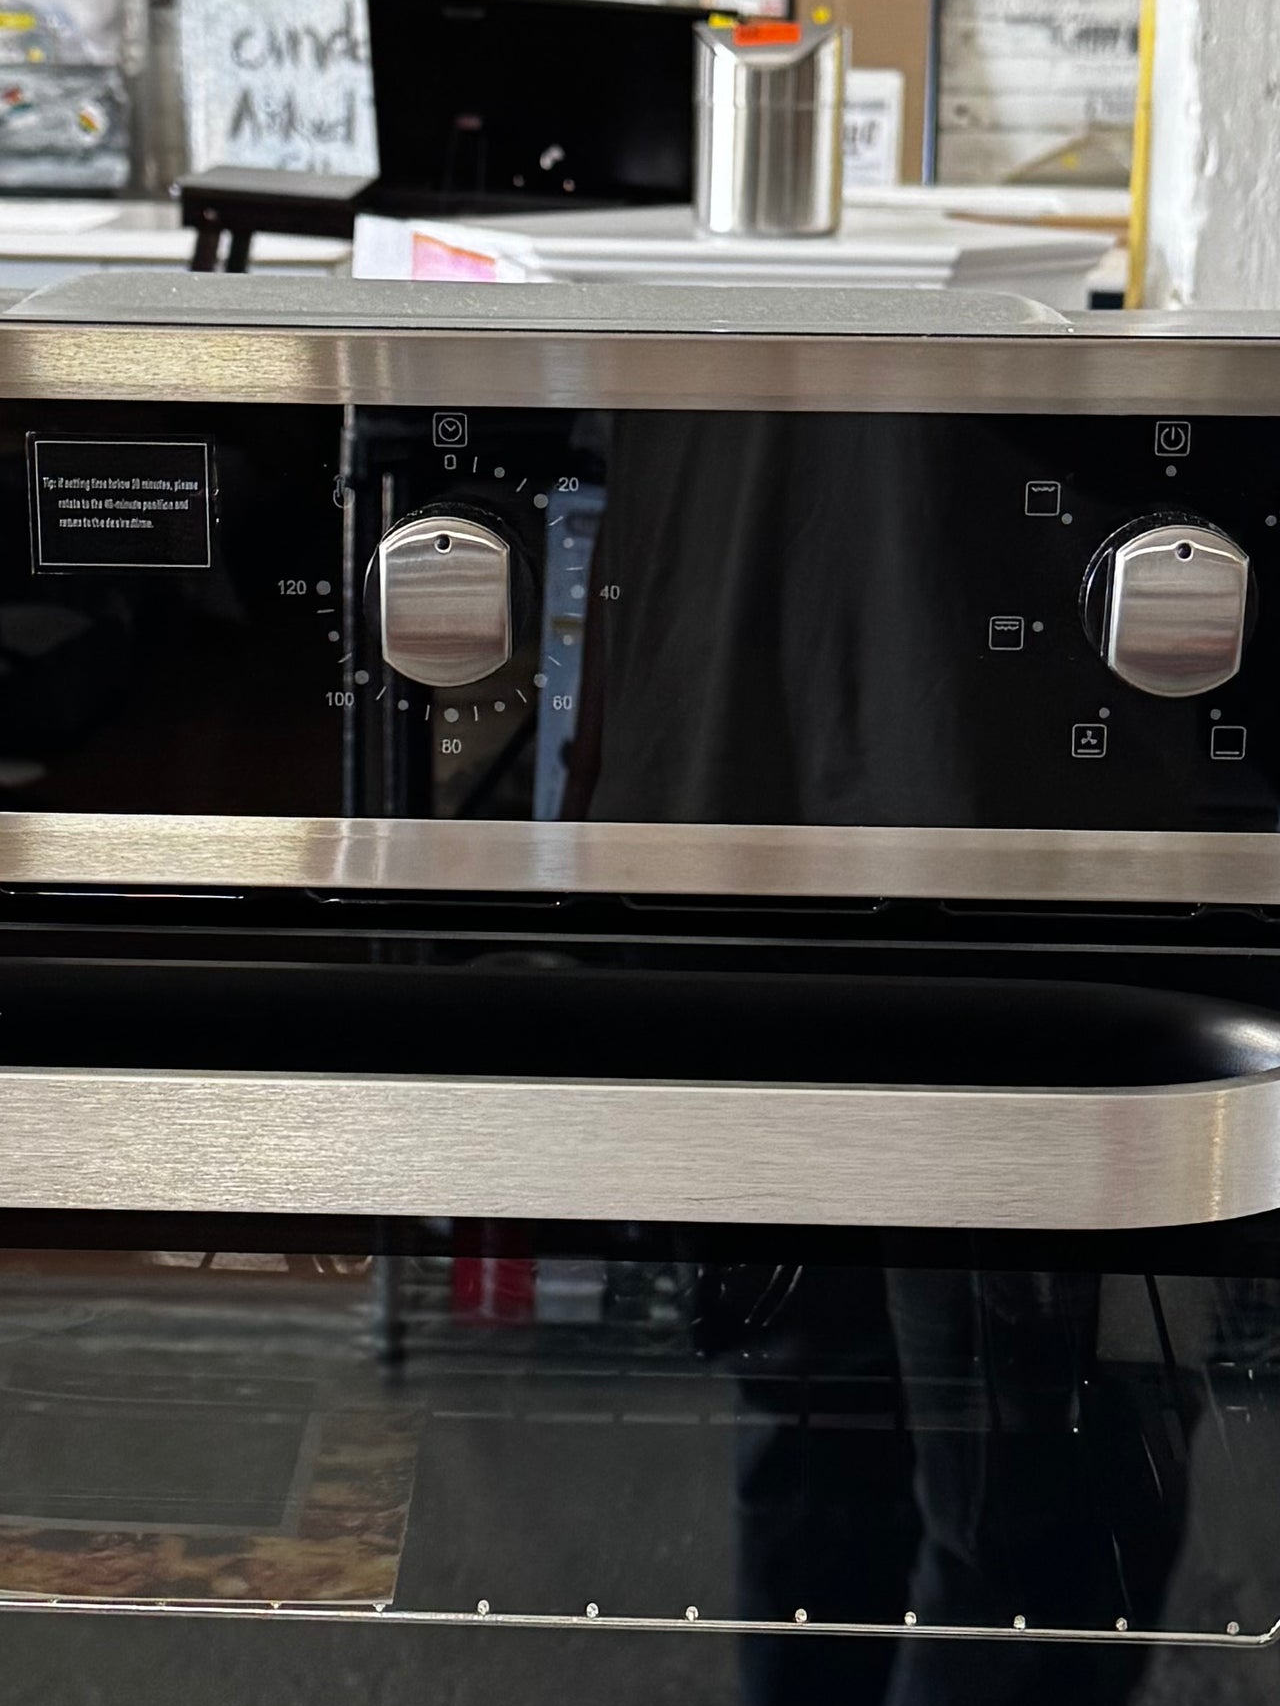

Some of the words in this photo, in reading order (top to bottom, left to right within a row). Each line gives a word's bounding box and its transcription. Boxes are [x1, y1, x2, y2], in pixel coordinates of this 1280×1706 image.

[558, 477, 579, 492] 20
[277, 579, 307, 595] 120
[599, 585, 621, 600] 40
[325, 691, 355, 708] 100
[552, 695, 573, 711] 60
[441, 738, 462, 754] 80
